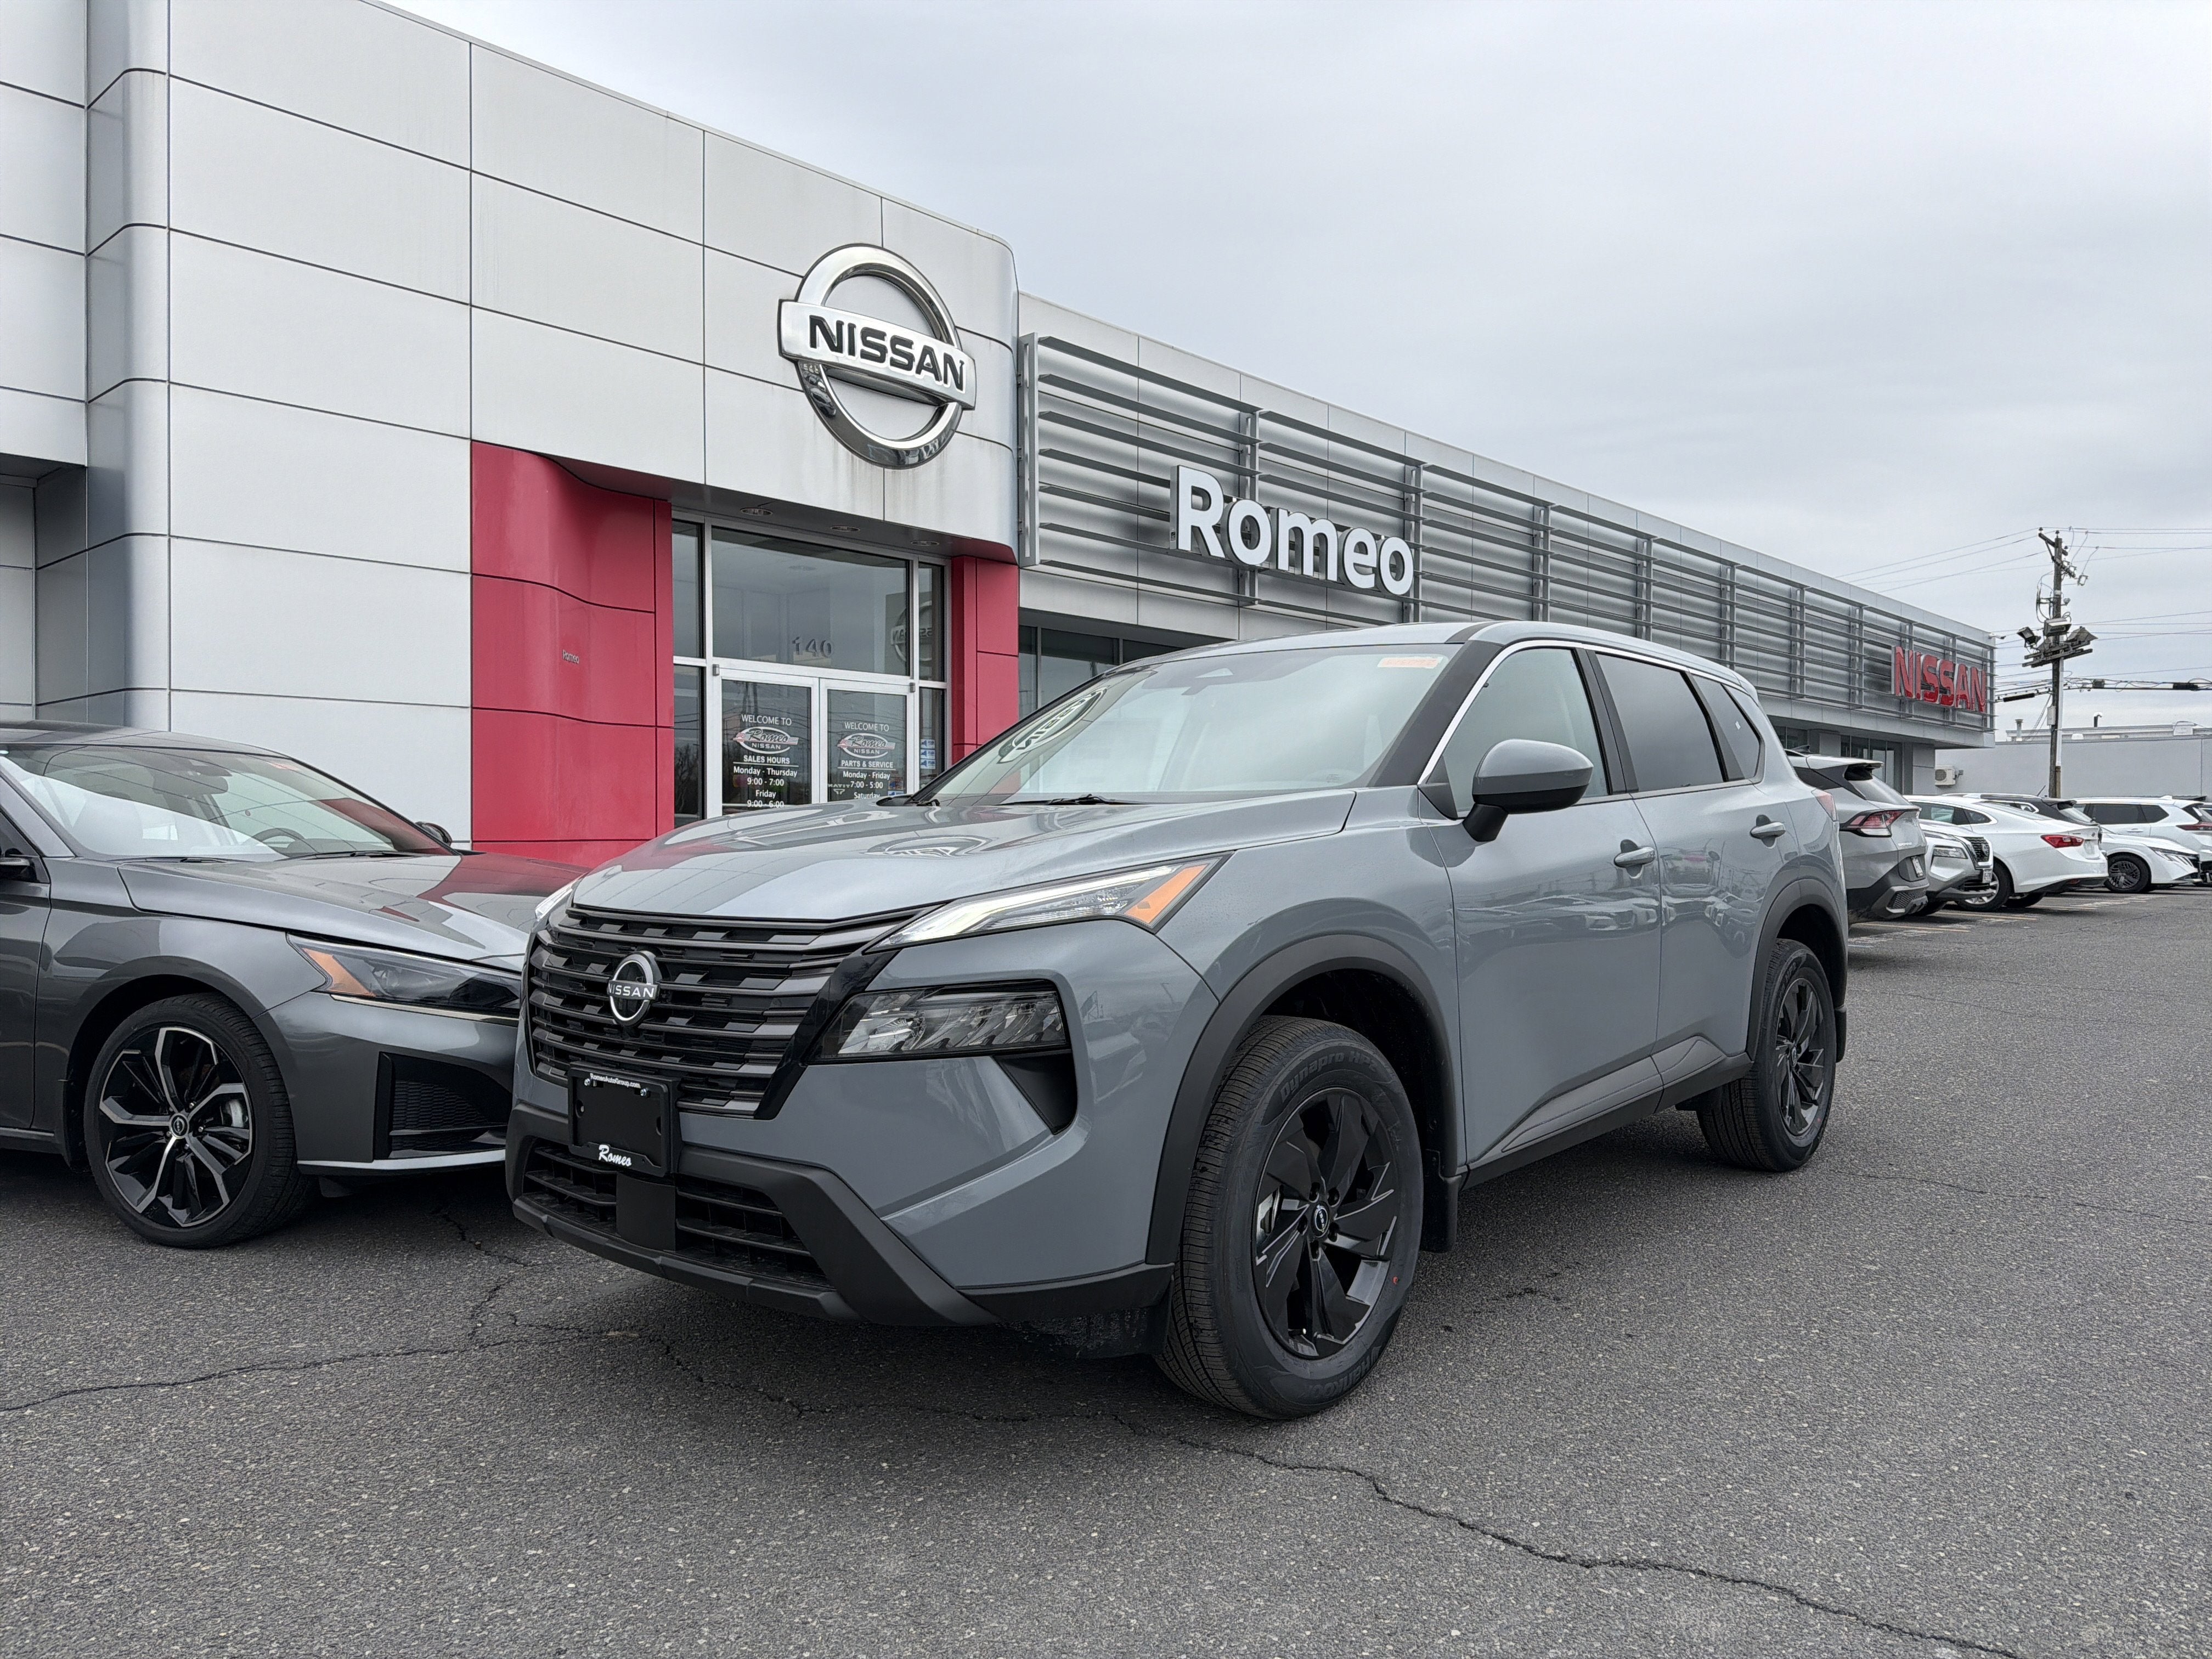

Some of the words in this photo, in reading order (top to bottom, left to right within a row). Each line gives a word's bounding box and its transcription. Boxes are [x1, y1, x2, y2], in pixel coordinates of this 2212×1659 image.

[809, 314, 964, 392] NISSAN
[1170, 465, 1414, 595] Romeo
[792, 636, 833, 658] 140
[1892, 646, 1987, 713] NISSAN
[741, 714, 780, 725] WELCOME
[781, 718, 792, 726] TO
[844, 722, 878, 730] WELCOME
[746, 728, 789, 743] Romeo
[850, 735, 887, 748] Romeo
[743, 755, 765, 763] SALES
[733, 766, 761, 776] Monday
[766, 768, 798, 778] Thursday
[843, 771, 867, 781] Monday
[872, 772, 890, 781] Friday
[755, 789, 776, 799] Friday
[607, 983, 654, 998] NISSAN
[590, 1073, 641, 1089] RomeoAutoGroup.com
[1279, 1052, 1345, 1103] Dynapro
[599, 1144, 632, 1167] Romeo
